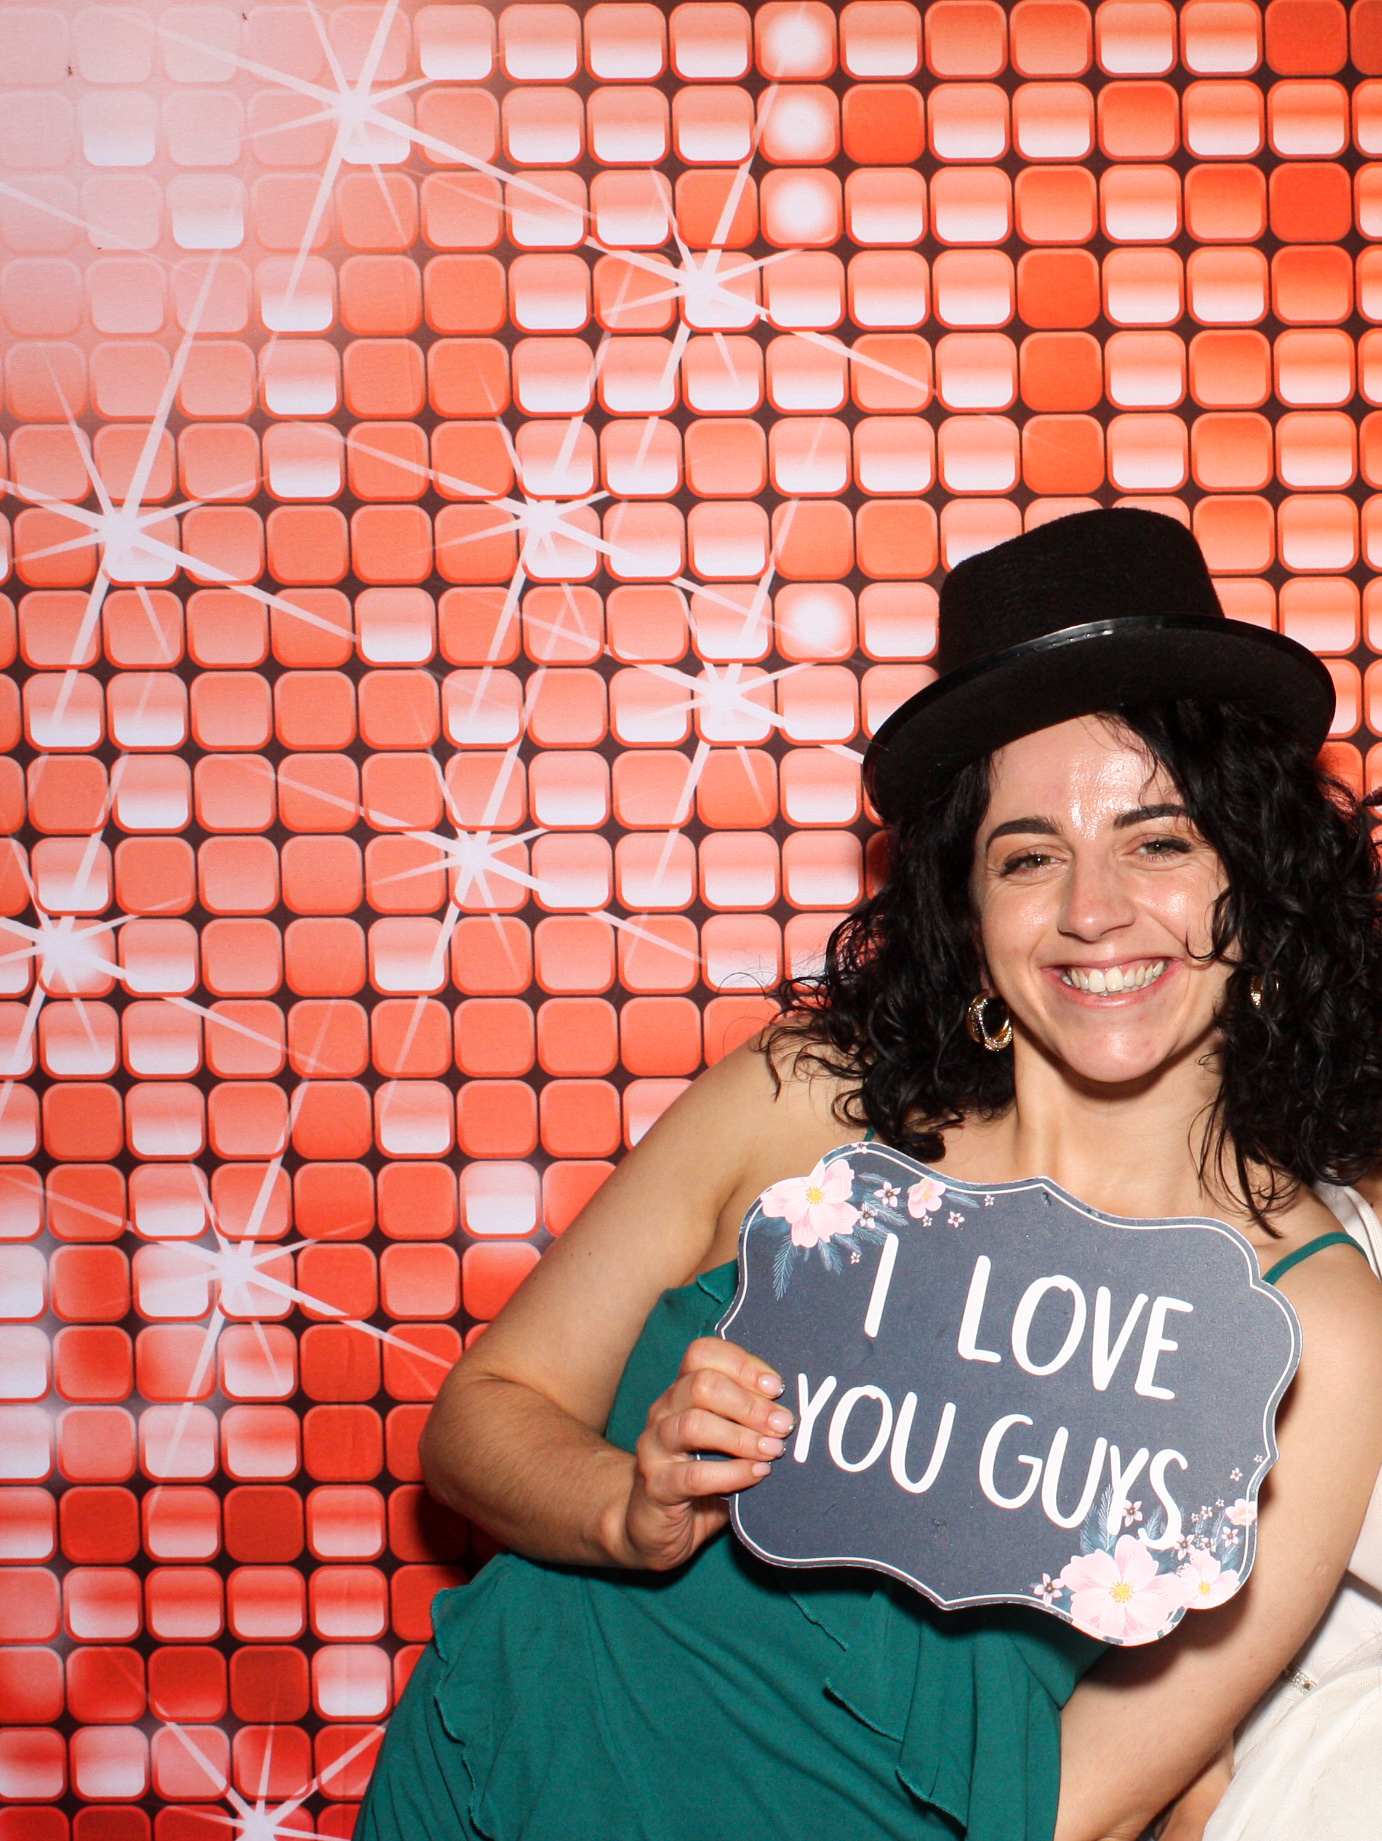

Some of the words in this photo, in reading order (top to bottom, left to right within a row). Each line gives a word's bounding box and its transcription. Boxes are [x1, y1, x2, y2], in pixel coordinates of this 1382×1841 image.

[864, 1233, 899, 1338] I
[957, 1255, 1194, 1400] LOVE
[793, 1372, 956, 1494] YOU
[979, 1413, 1188, 1551] GUYS
